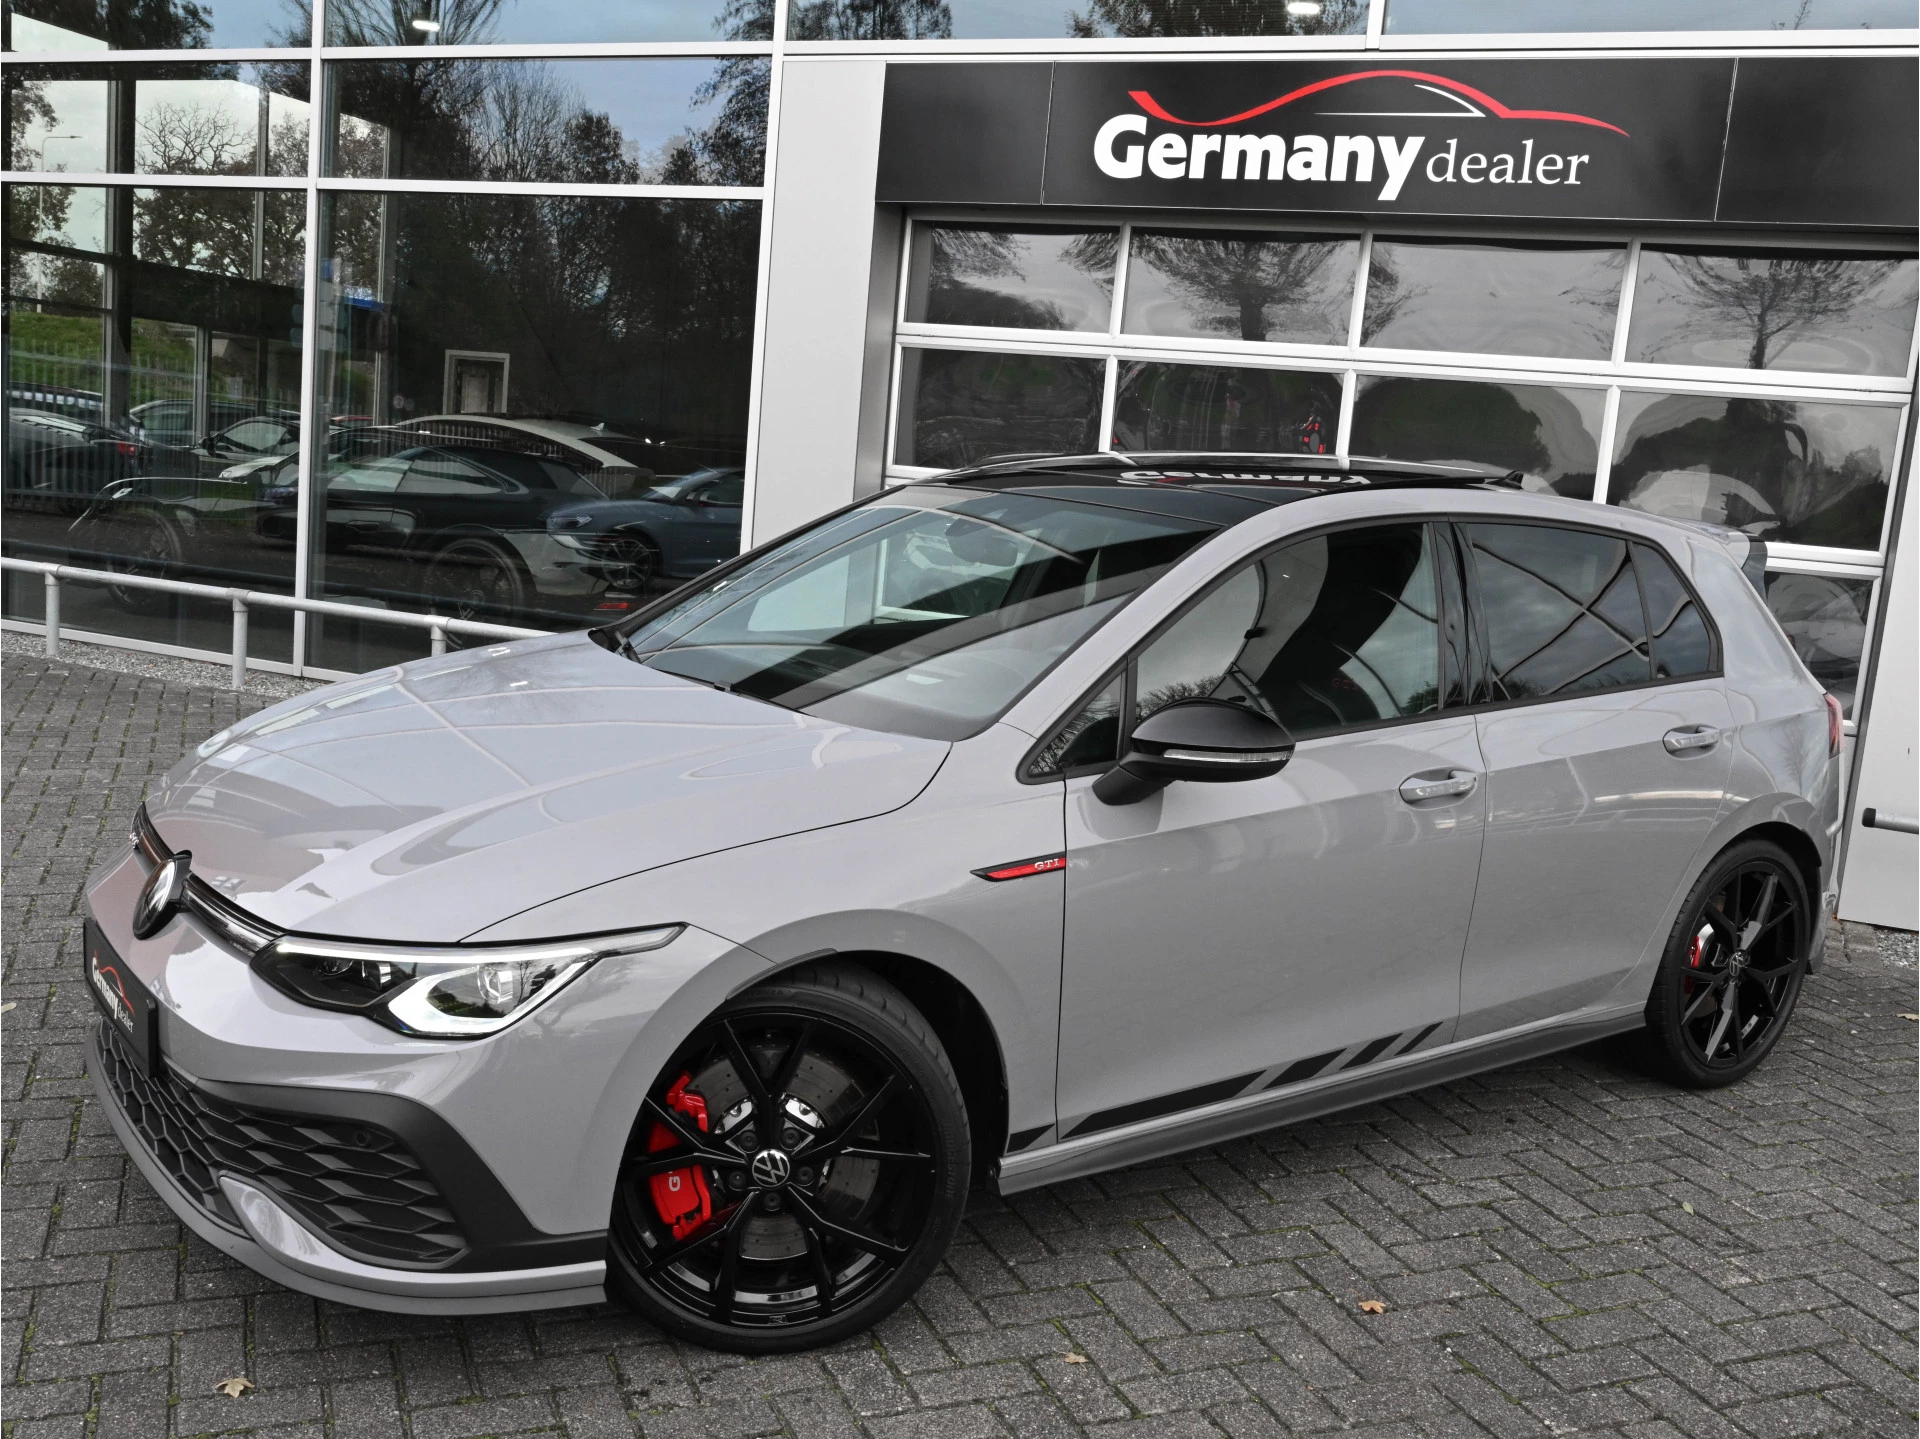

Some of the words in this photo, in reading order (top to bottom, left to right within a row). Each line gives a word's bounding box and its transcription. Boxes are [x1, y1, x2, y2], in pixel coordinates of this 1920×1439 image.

[1094, 114, 1426, 201] Germany
[1426, 138, 1590, 187] dealer
[1034, 858, 1060, 871] GTI
[92, 956, 119, 1020] Germany
[118, 1002, 134, 1033] dealer
